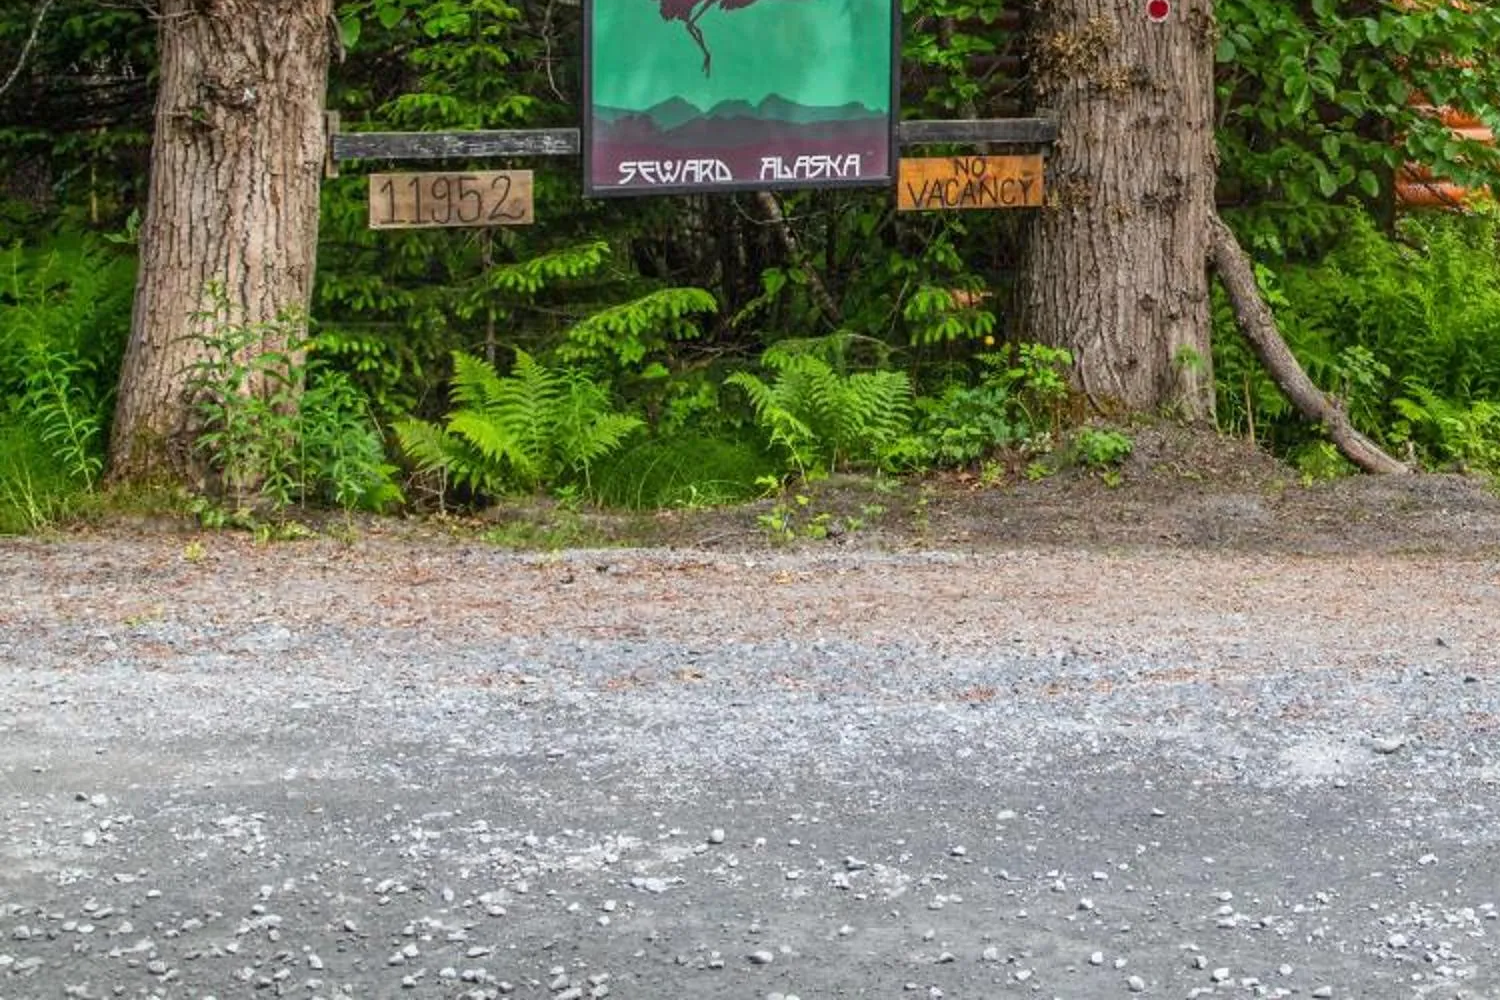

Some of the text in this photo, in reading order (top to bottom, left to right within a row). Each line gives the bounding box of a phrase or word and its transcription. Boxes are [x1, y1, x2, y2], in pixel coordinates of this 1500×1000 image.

[618, 153, 861, 185] SEWARD ALASKA
[953, 156, 987, 178] NO
[379, 174, 526, 225] 11952
[906, 176, 1034, 209] VACANCY
